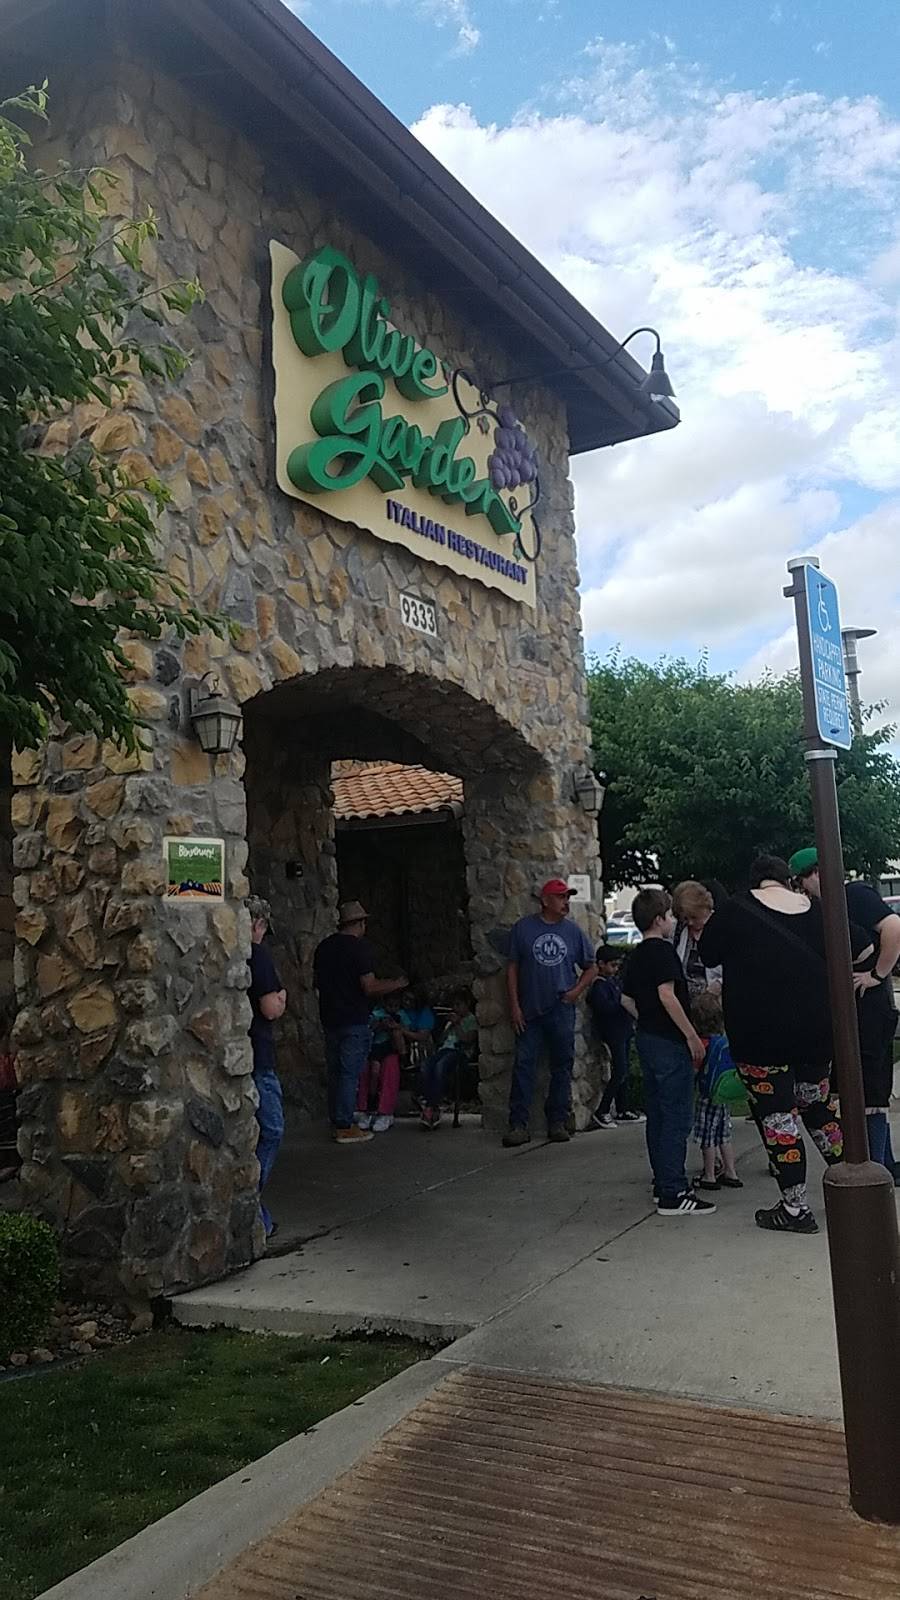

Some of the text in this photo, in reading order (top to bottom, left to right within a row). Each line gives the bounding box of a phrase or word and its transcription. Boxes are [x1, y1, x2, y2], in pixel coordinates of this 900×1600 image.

[282, 245, 449, 400] Olive
[287, 370, 521, 535] Garden
[387, 499, 528, 585] ITALIAN RESTAURANT
[402, 598, 435, 633] 9333
[818, 659, 842, 689] PARKING
